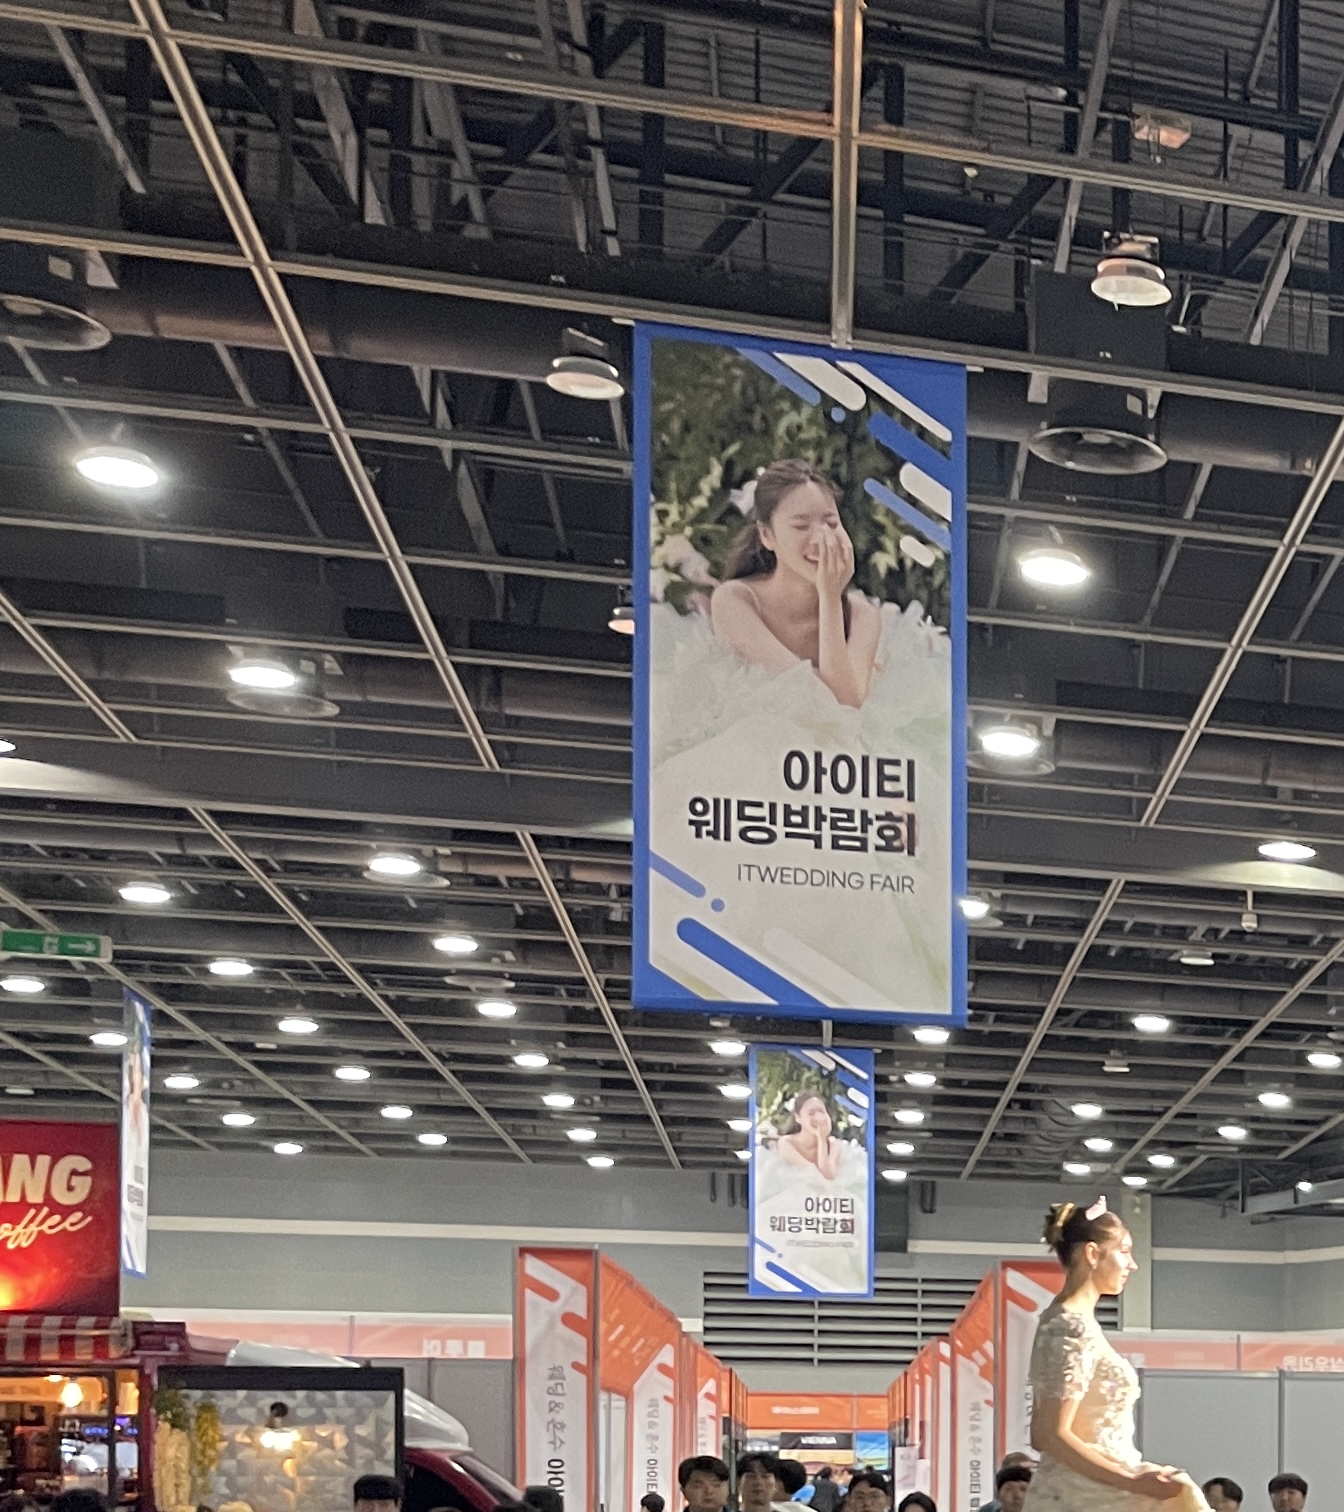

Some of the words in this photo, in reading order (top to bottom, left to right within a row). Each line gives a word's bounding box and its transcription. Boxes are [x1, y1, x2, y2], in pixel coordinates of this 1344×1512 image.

[783, 749, 916, 802] 아이티
[688, 796, 916, 857] 웨딩박람회
[737, 863, 864, 891] ITWEDDING
[869, 873, 915, 894] FAIR
[805, 1197, 855, 1214] 아이티
[0, 1206, 93, 1249] offee
[769, 1215, 855, 1235] 웨딩박람회
[547, 1458, 565, 1495] 아이
